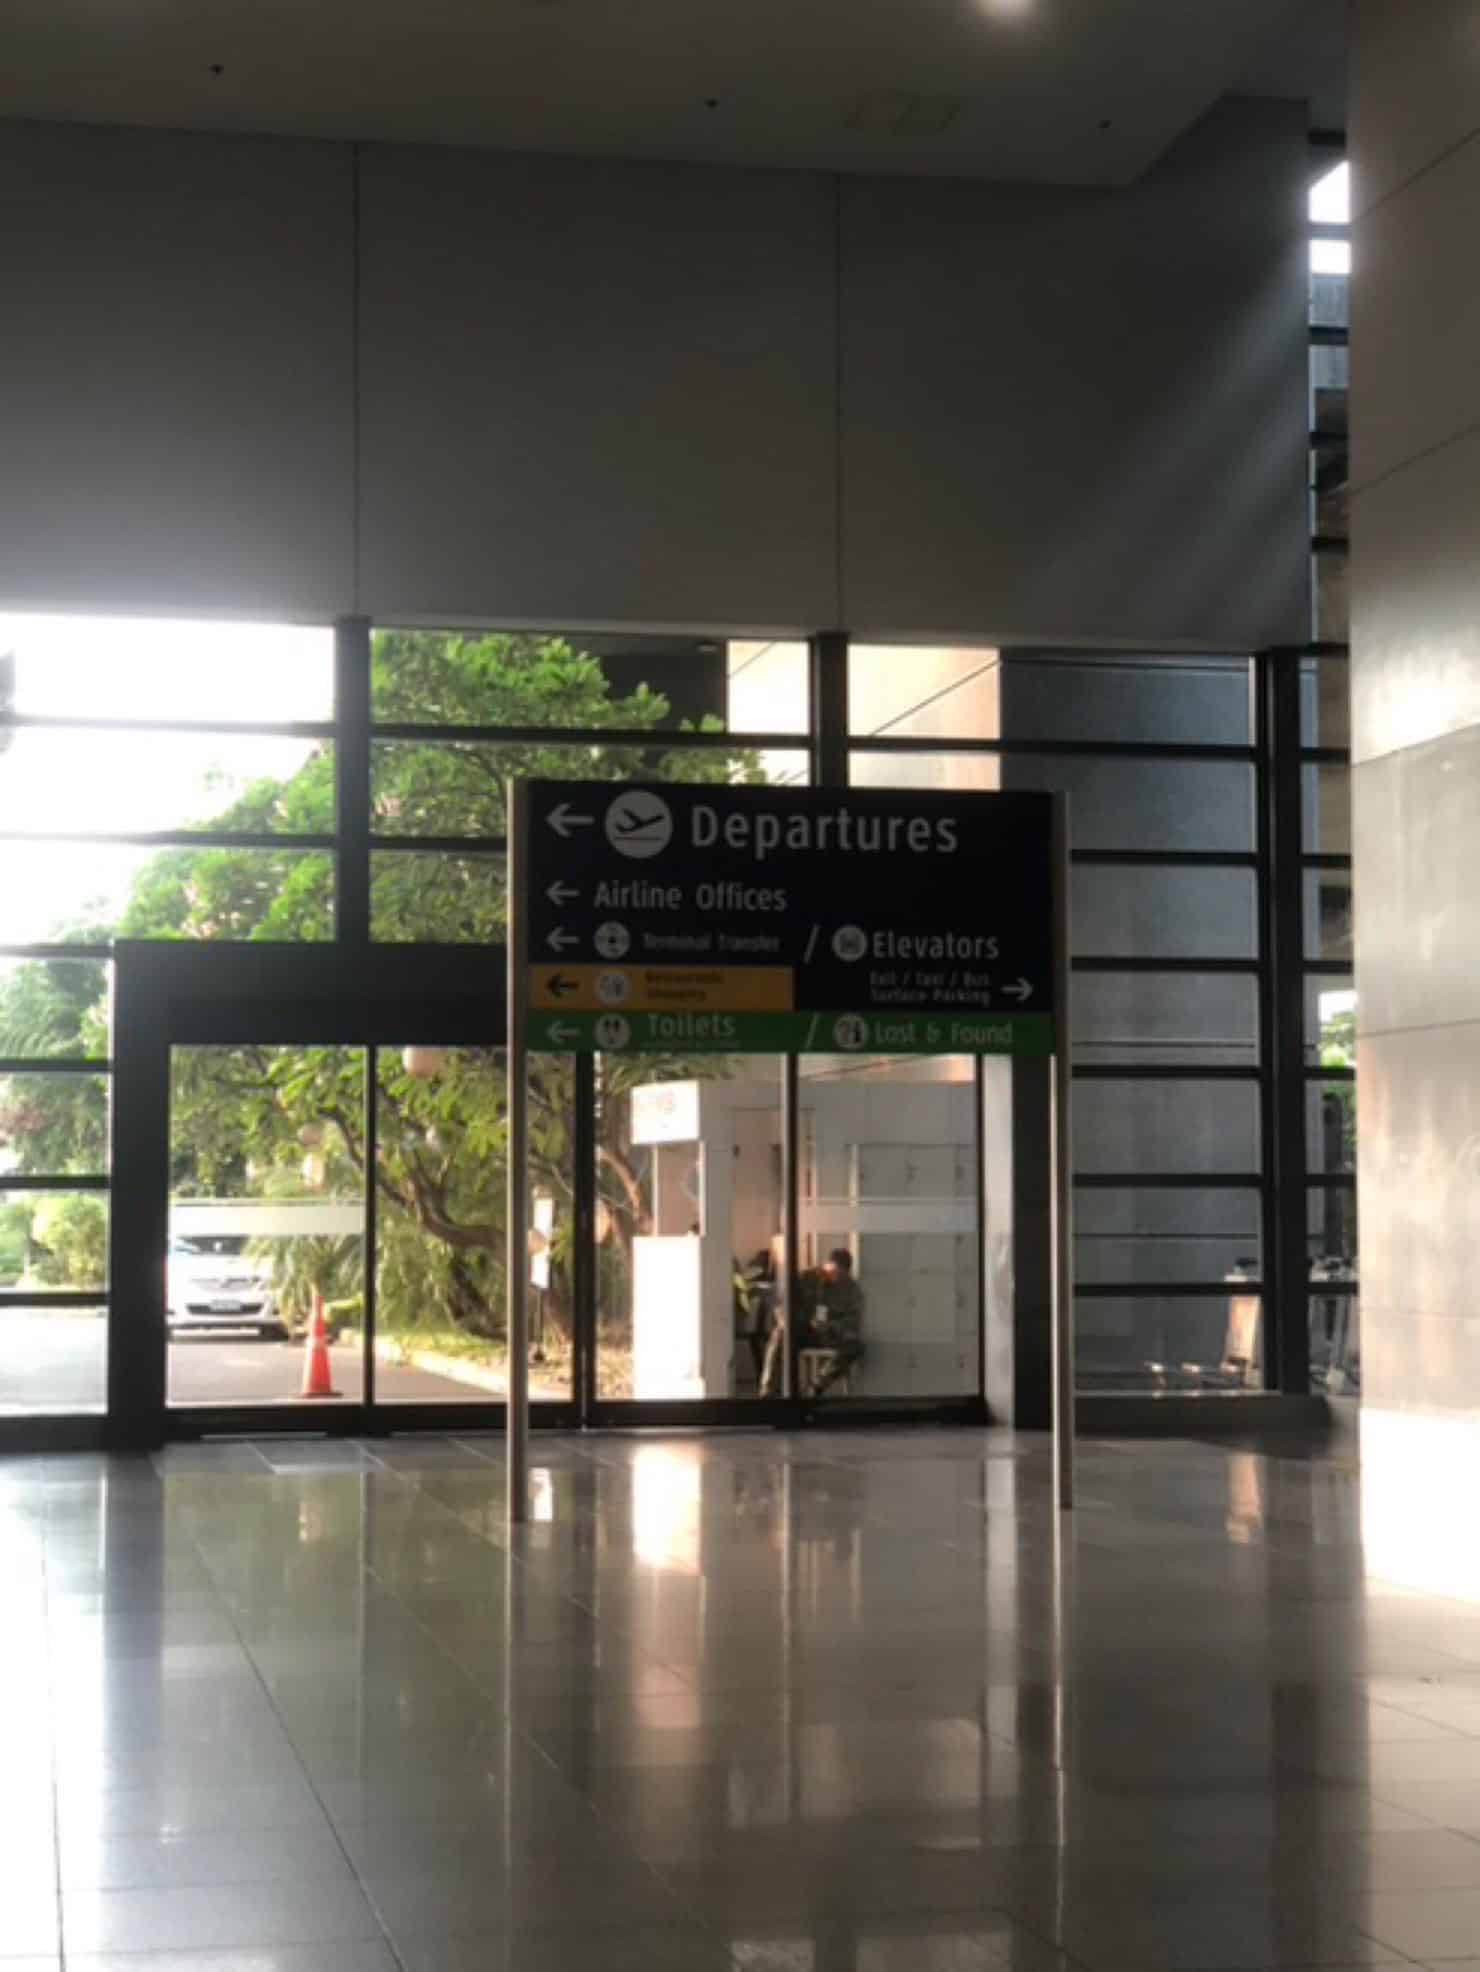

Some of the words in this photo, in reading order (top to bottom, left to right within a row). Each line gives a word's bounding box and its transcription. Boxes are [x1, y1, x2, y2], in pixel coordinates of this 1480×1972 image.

[691, 804, 959, 860] Departures
[593, 880, 682, 910] Airline
[697, 883, 788, 912] Offices
[872, 930, 1000, 960] Elevators
[647, 1012, 737, 1038] Toilets
[873, 1021, 914, 1044] Lost
[951, 1020, 1014, 1045] Found
